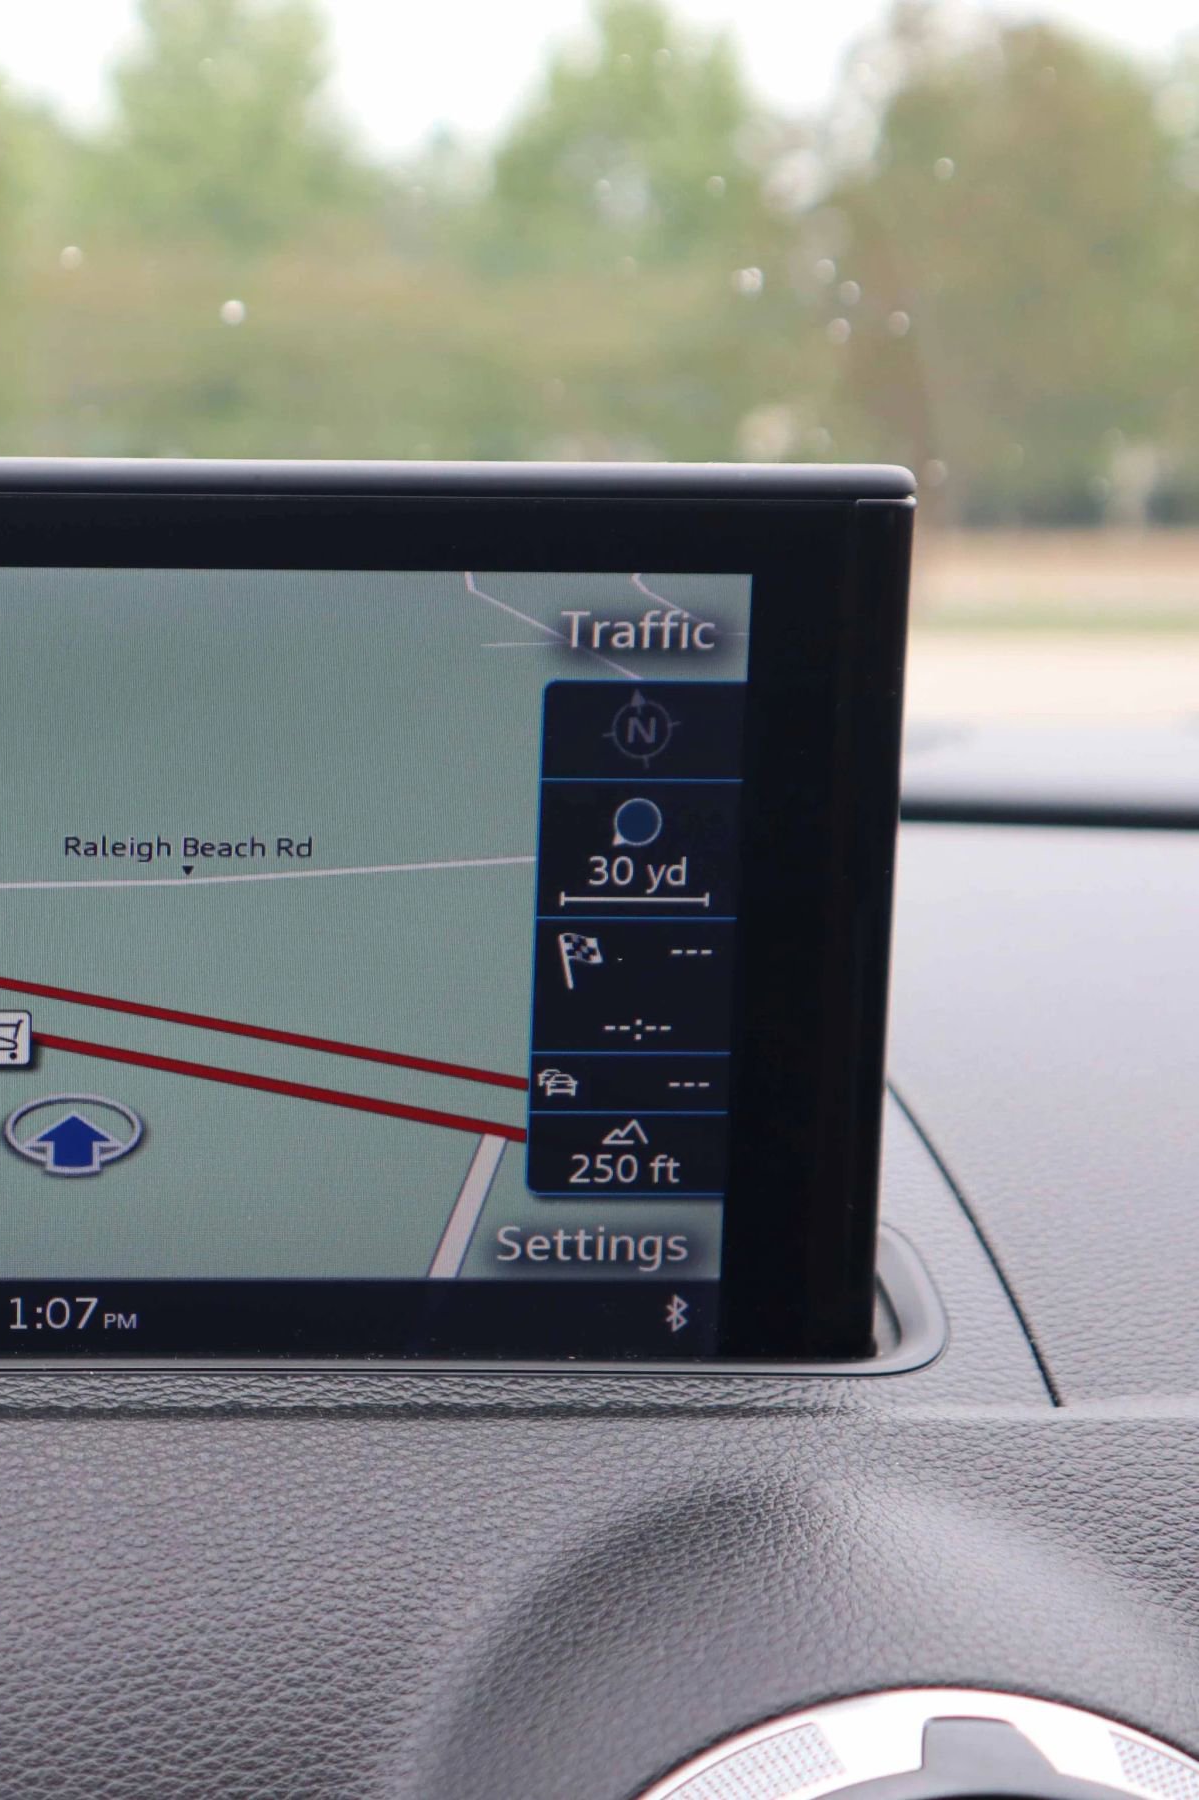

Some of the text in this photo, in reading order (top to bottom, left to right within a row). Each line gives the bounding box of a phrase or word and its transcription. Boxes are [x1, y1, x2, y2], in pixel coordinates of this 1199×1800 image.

[560, 610, 716, 649] Traffic
[626, 716, 657, 744] N
[64, 835, 313, 862] Raleigh Beach Rd
[588, 856, 687, 894] 30 yd
[569, 1154, 680, 1184] 250 ft
[496, 1225, 689, 1272] Settings
[9, 1297, 138, 1330] 1:07 PM
